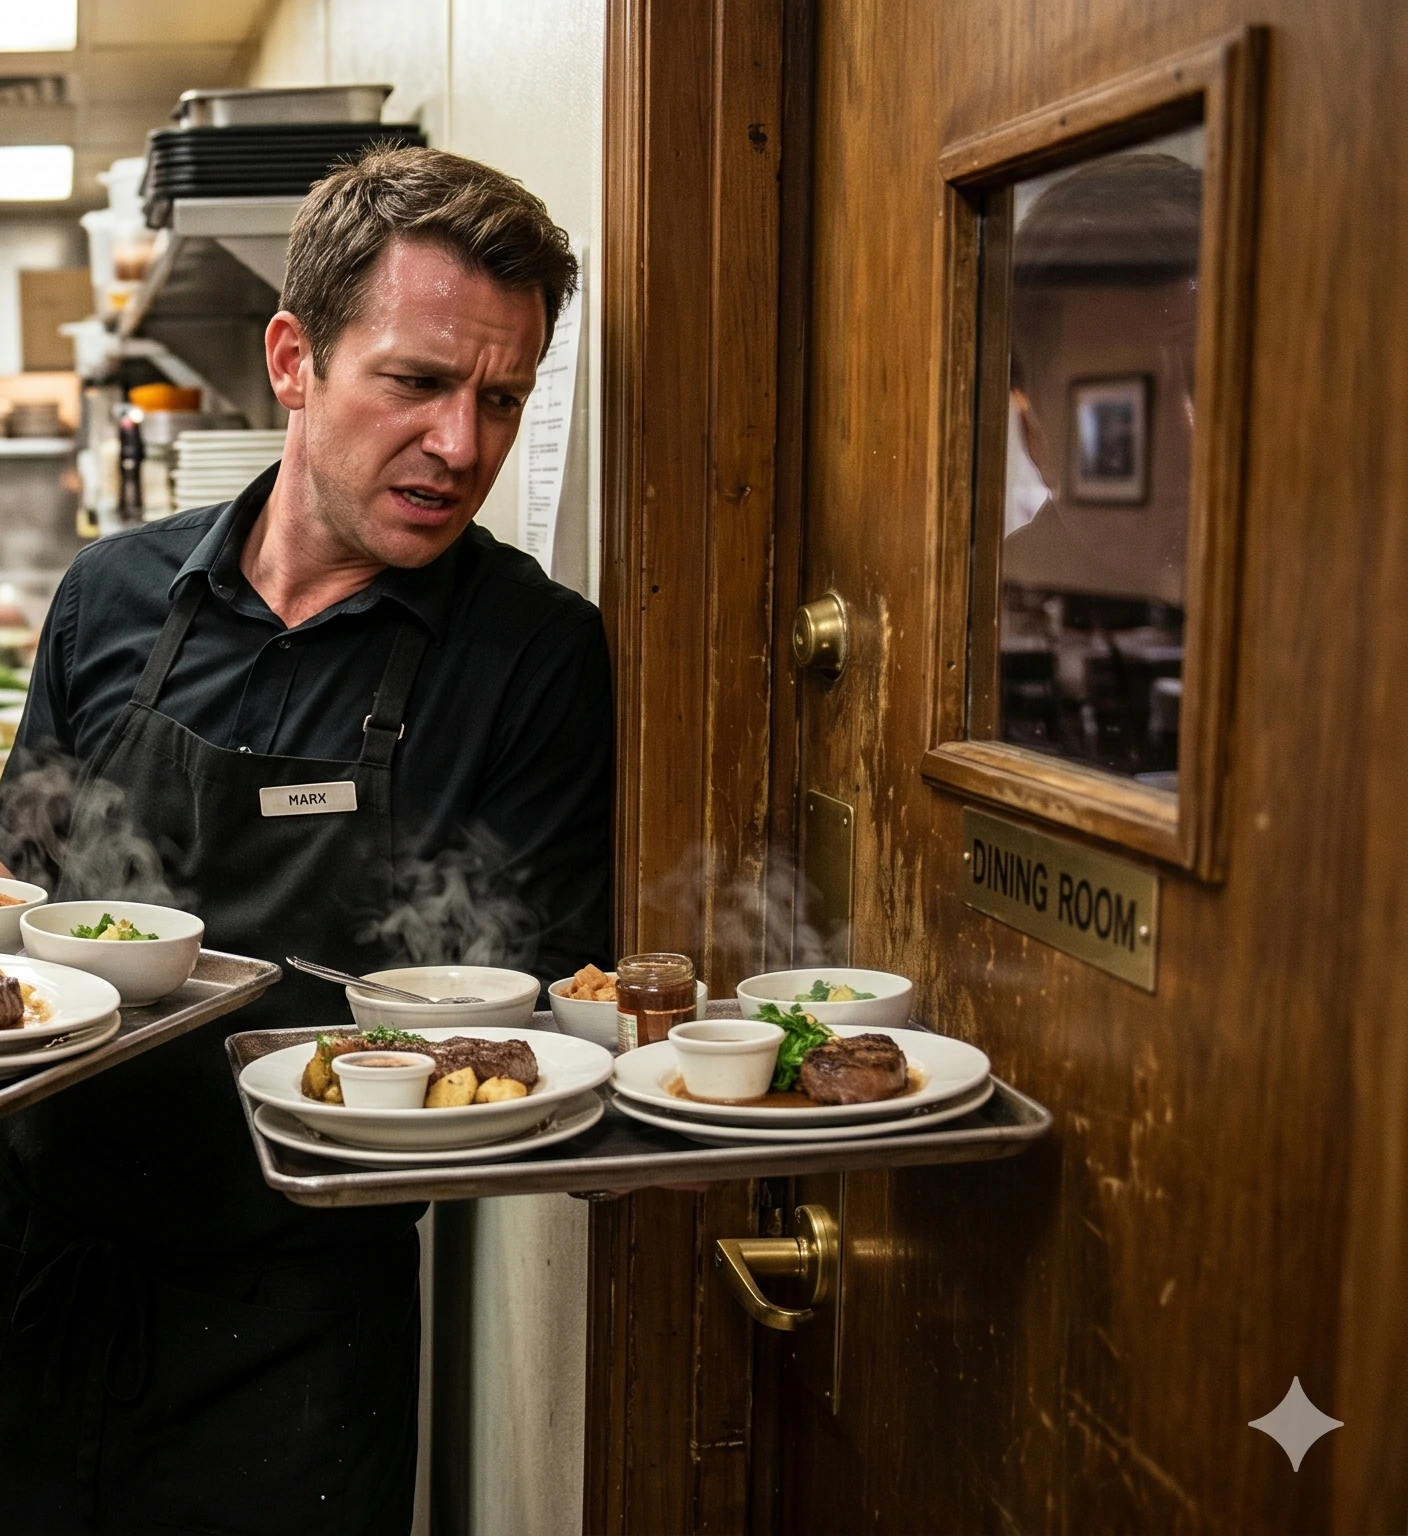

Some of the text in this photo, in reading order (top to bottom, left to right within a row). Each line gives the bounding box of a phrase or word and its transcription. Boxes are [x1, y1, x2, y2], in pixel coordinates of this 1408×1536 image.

[288, 792, 327, 806] MARX
[972, 837, 1136, 954] DINING ROOM
